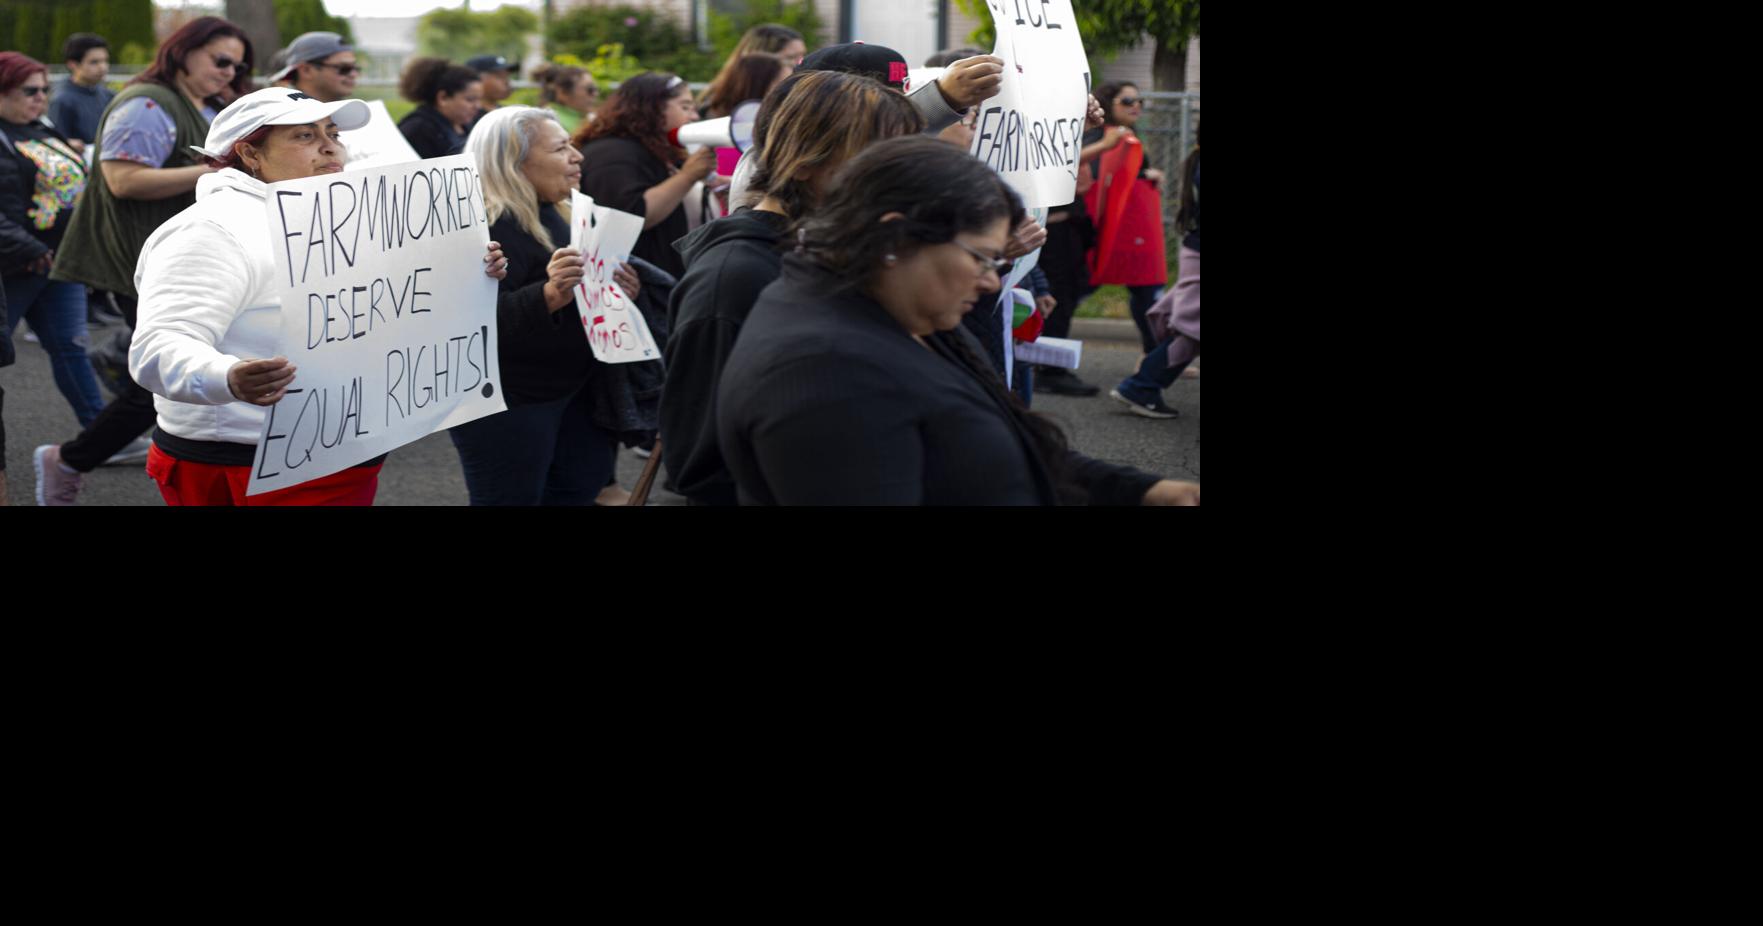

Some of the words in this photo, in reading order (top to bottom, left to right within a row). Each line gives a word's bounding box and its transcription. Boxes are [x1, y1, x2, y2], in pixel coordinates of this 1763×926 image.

[992, 0, 1062, 29] ICE
[977, 106, 1084, 178] FARMORKER
[307, 268, 431, 350] DESERVE
[257, 376, 368, 479] EQUAL
[386, 325, 494, 427] RIGHTS!
